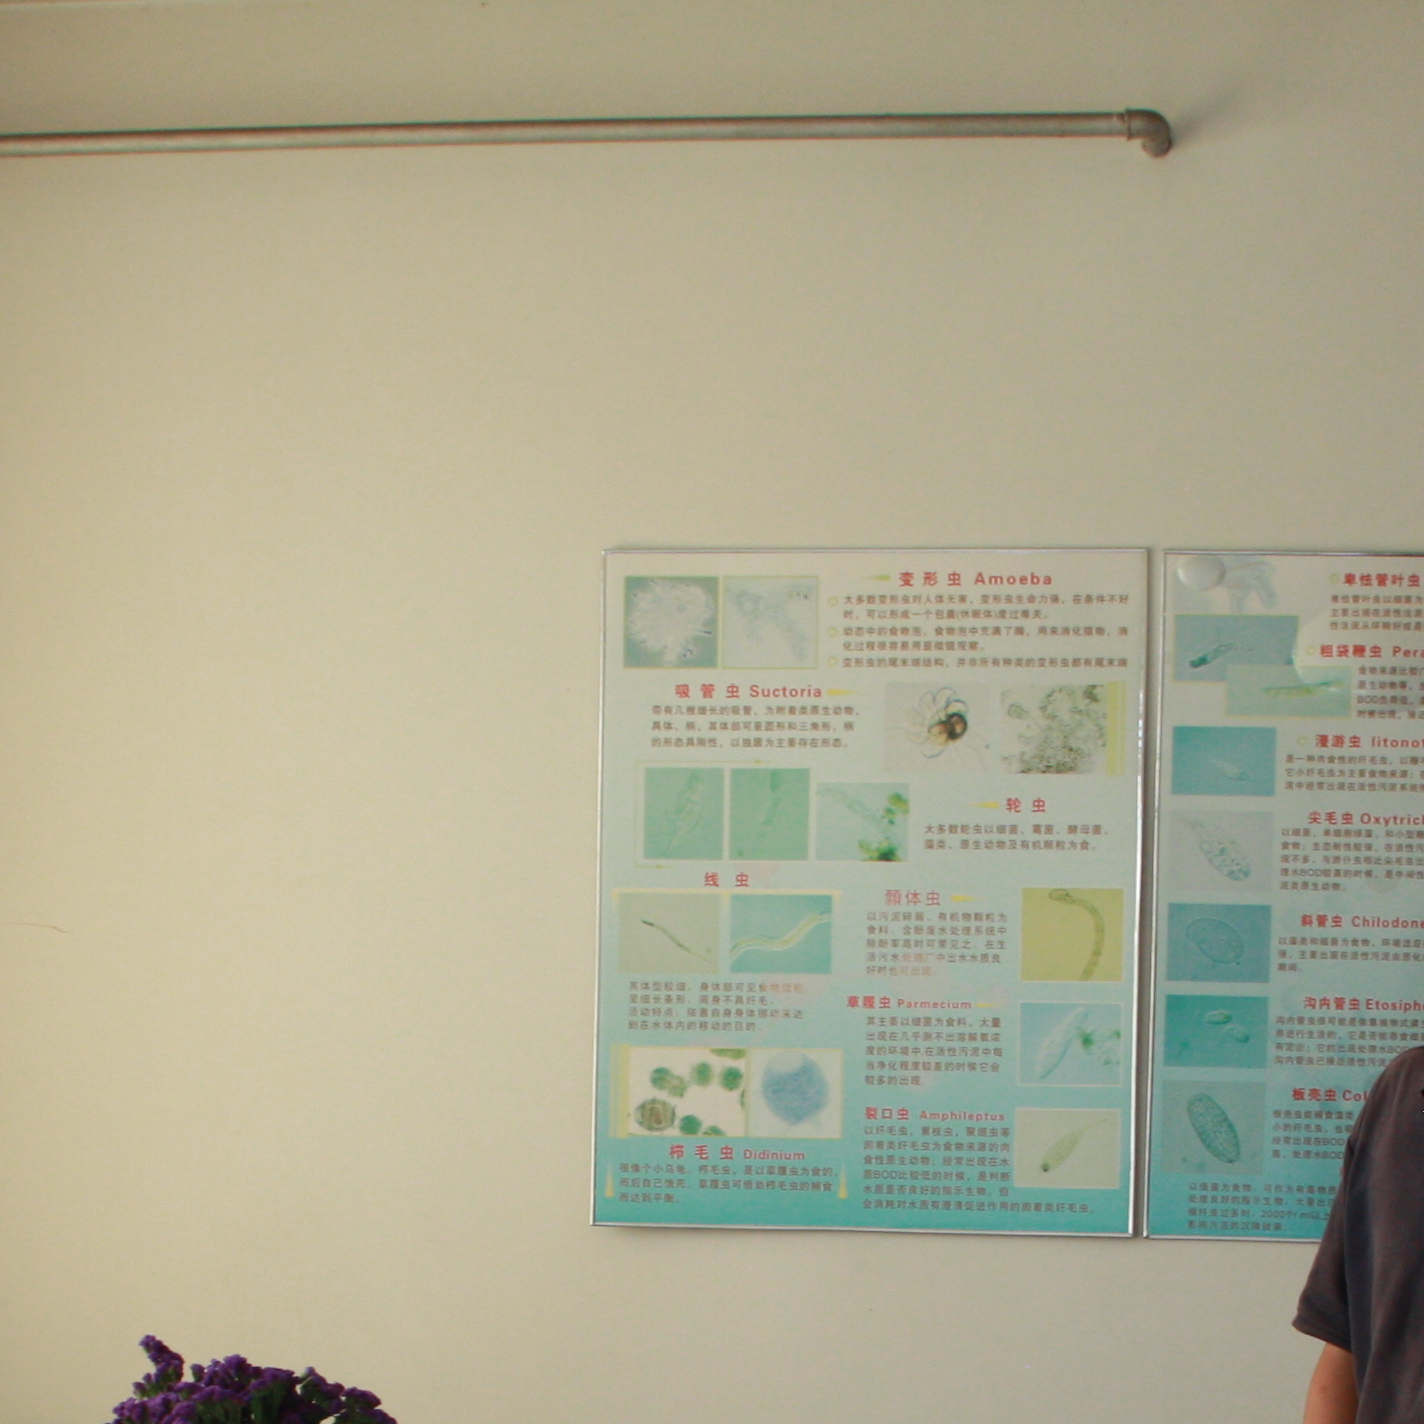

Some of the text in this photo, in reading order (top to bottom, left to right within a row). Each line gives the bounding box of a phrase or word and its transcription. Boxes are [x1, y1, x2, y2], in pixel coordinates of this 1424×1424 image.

[899, 572, 1052, 587] 变形虫 Amoeba
[675, 684, 822, 699] 吸管虫 Suctoria
[1315, 734, 1361, 749] 漫游虫
[1005, 798, 1046, 813] 轮虫
[1308, 811, 1354, 825] 尖毛虫
[704, 872, 749, 888] 线虫
[1301, 914, 1343, 928] 斜管虫
[847, 995, 972, 1009] 草履虫 Parmecium
[1304, 996, 1361, 1011] 沟内管虫
[864, 1107, 1005, 1122] 裂口虫 Amphileptus
[743, 1149, 805, 1161] Didinium
